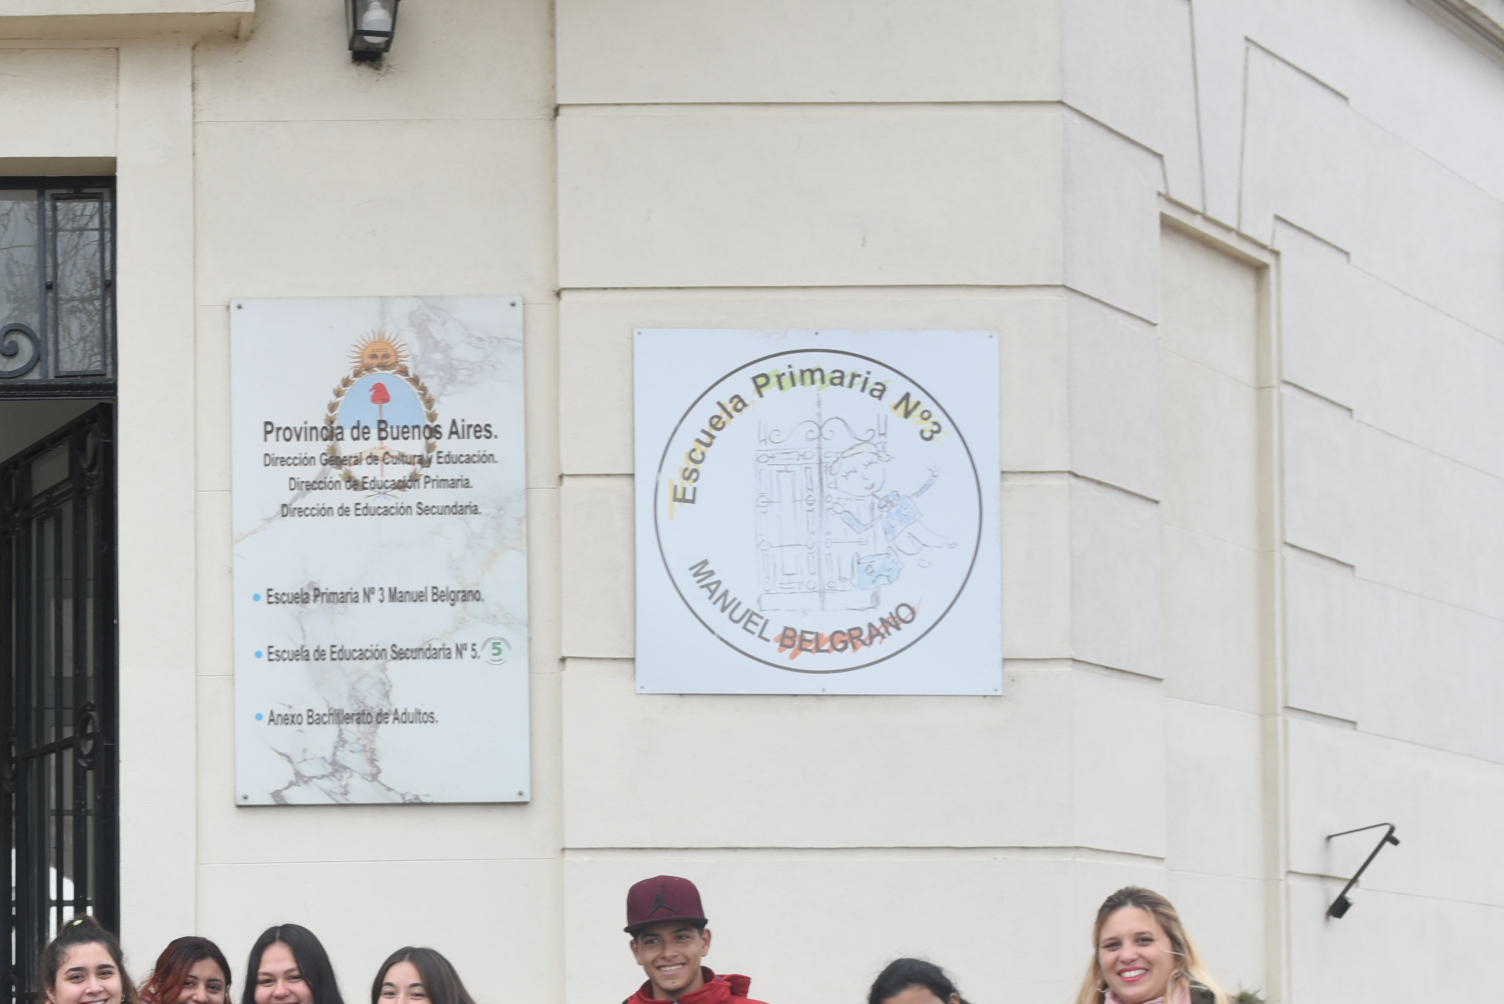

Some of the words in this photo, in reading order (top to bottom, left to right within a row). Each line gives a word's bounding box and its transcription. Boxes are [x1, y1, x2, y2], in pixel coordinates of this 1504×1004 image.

[264, 420, 344, 442] Provincia
[351, 420, 370, 441] de
[377, 419, 442, 441] Buenos
[448, 418, 498, 440] Aires.
[672, 393, 749, 504] Escuela
[751, 365, 888, 400] Primaria
[264, 453, 316, 467] Dirección
[319, 452, 362, 467] General
[366, 452, 379, 466] de
[382, 451, 424, 465] Cultura
[436, 450, 498, 465] Educación.
[289, 476, 341, 491] Dirección
[344, 476, 358, 491] de
[363, 475, 420, 490] Educación
[424, 474, 473, 489] Primaria.
[281, 502, 334, 518] Dirección
[337, 502, 350, 517] de
[354, 501, 412, 517] Educación
[416, 501, 482, 516] Secundaria.
[266, 588, 310, 605] Escuela
[313, 587, 359, 604] Primaria
[378, 587, 385, 603] 3
[388, 586, 428, 603] Manuel
[431, 586, 484, 606] Belgrano.
[688, 558, 771, 642] MANUEL
[778, 602, 916, 653] BELGRANO
[267, 645, 310, 662] Escuela
[313, 645, 327, 661] de
[330, 644, 385, 661] Educación
[390, 643, 452, 661] Secundaria
[491, 642, 502, 656] 5
[268, 709, 303, 726] Anexo
[307, 708, 373, 726] Bachillerato
[375, 708, 390, 725] de
[392, 707, 439, 725] Adultos.
